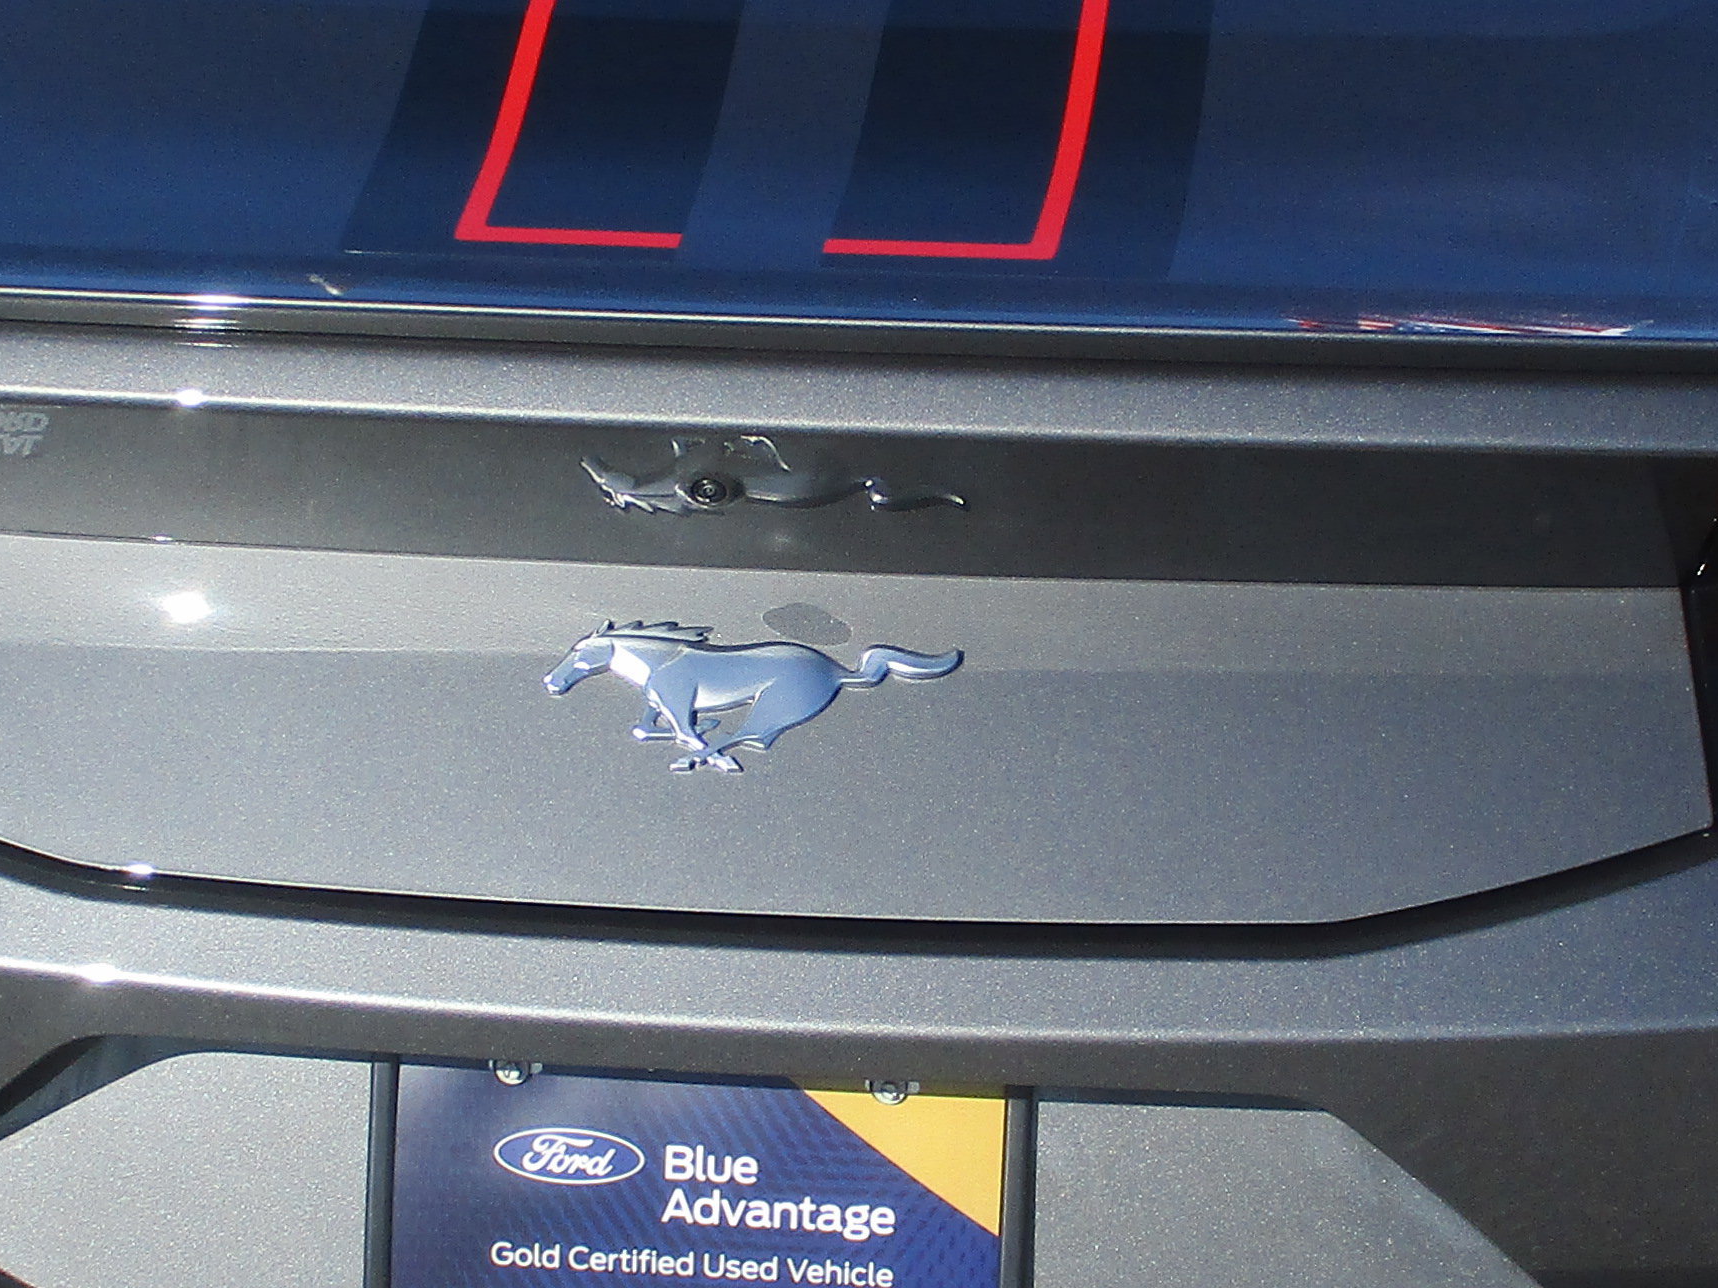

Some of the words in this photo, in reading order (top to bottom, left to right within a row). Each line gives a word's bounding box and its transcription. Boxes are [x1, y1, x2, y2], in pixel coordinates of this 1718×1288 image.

[522, 1133, 619, 1178] Ford
[665, 1146, 758, 1184] Blue
[661, 1189, 895, 1241] Advantage
[491, 1241, 561, 1269] Gold
[567, 1246, 695, 1279] Certified
[703, 1256, 778, 1282] Used
[788, 1259, 894, 1288] Vehicle
